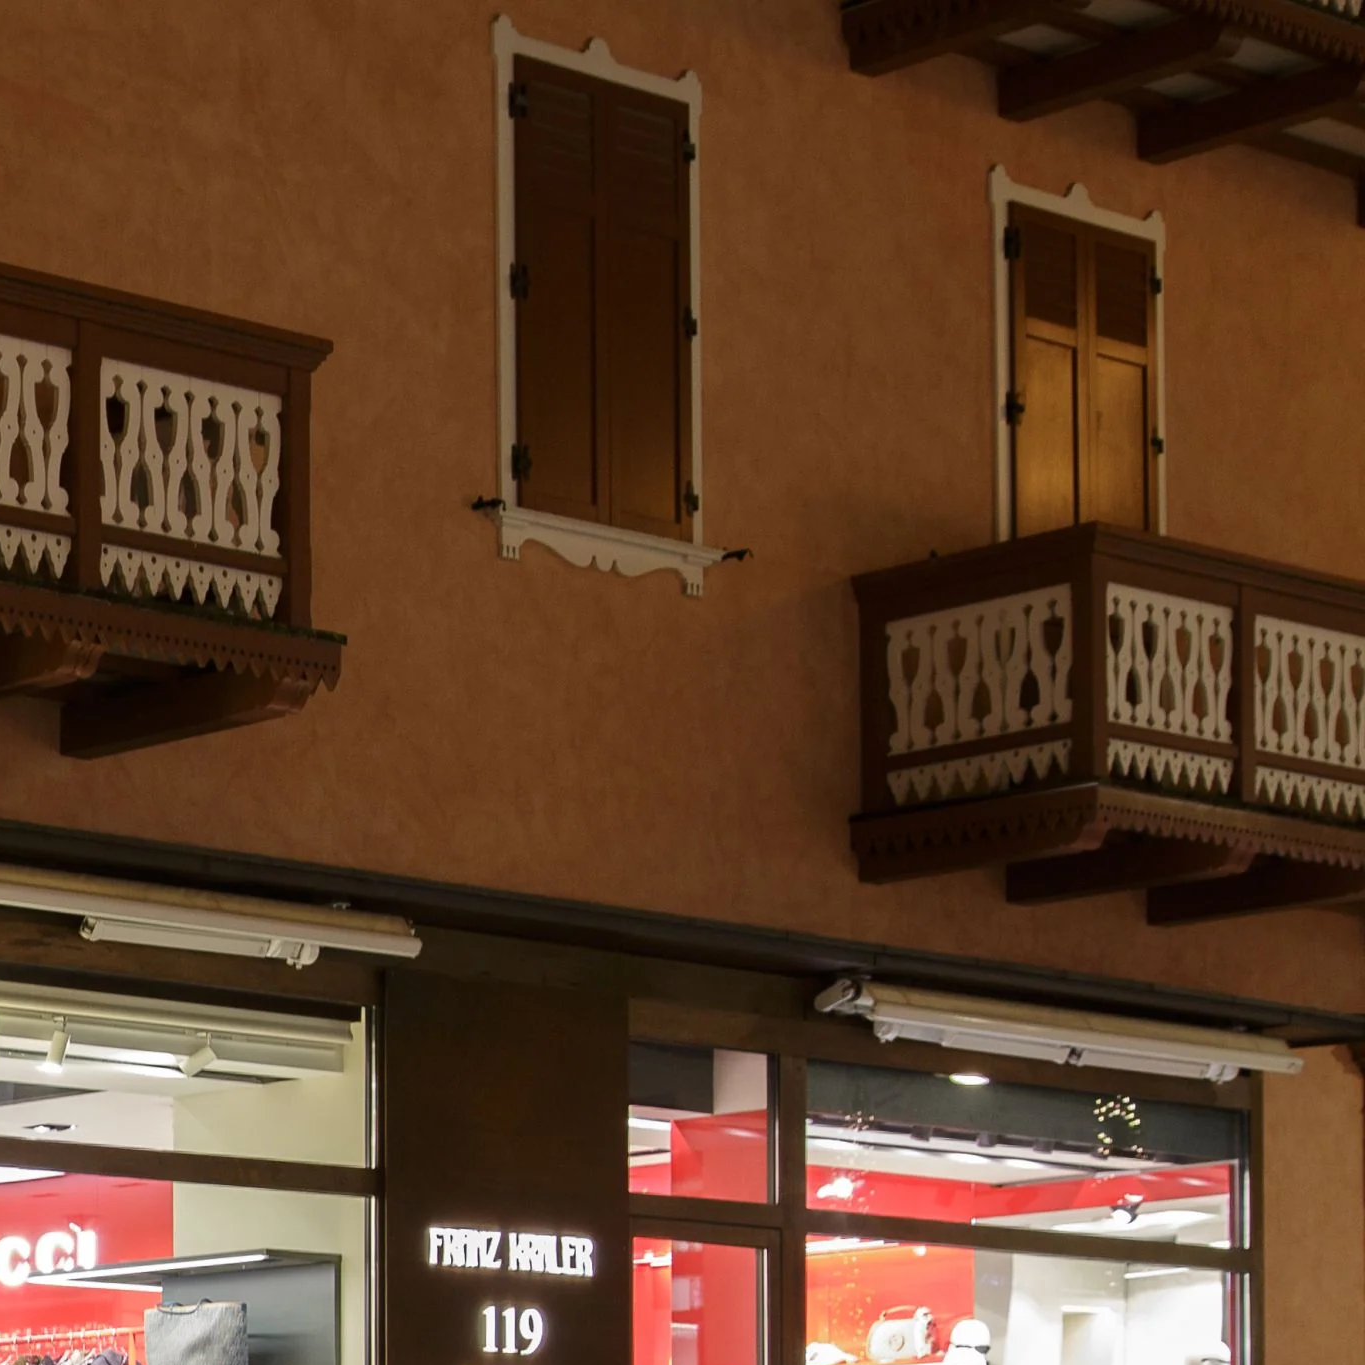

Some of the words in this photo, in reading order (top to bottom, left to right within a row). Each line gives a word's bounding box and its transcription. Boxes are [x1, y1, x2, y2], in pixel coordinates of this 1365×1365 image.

[428, 1227, 502, 1268] FRANZ
[508, 1232, 593, 1277] KRALER
[482, 1306, 543, 1356] 119
